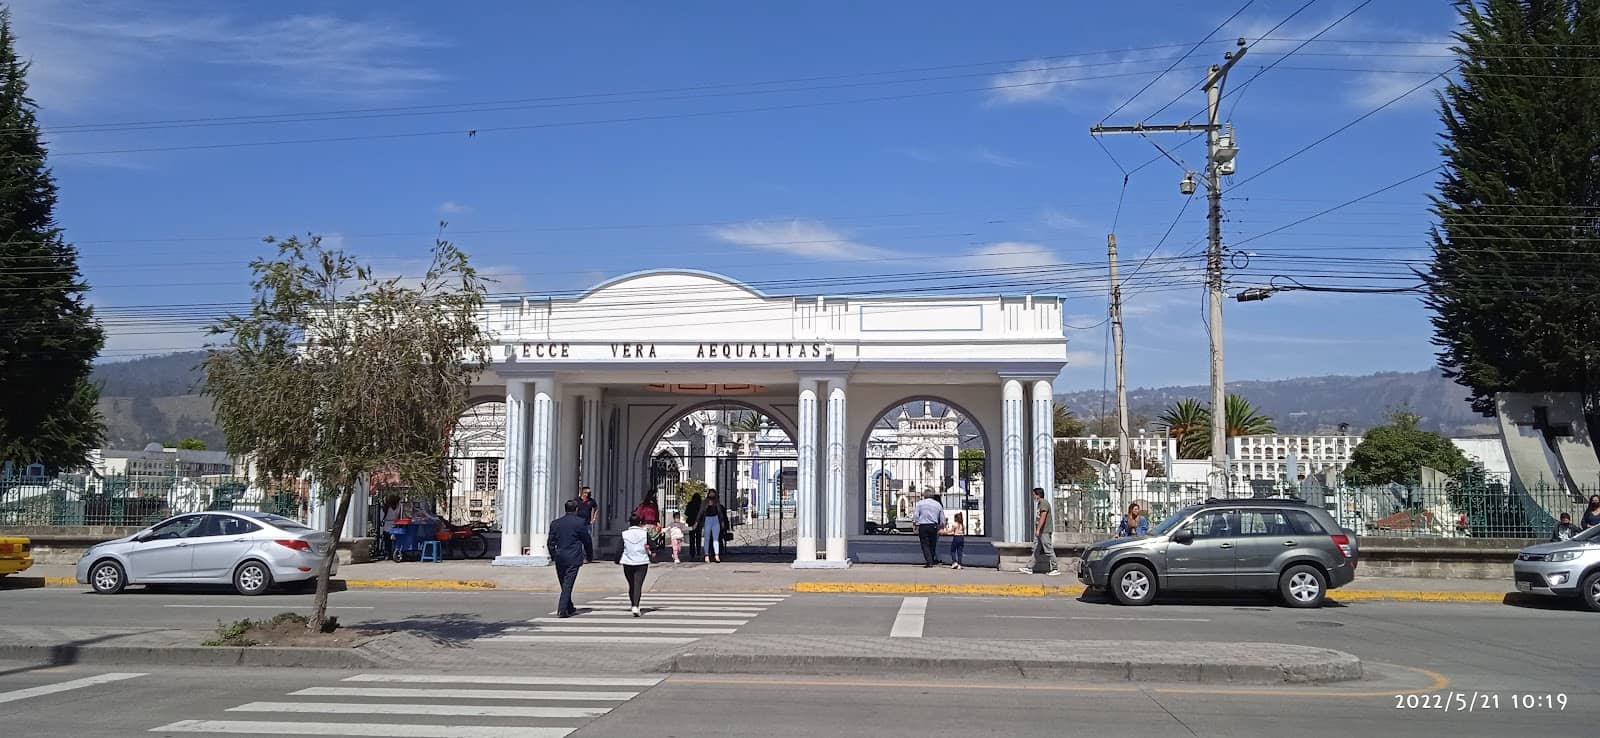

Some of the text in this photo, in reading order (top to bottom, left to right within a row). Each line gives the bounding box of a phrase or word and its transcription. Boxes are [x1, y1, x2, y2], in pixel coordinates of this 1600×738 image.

[522, 343, 821, 358] ECCE VERA AEQUALITAS
